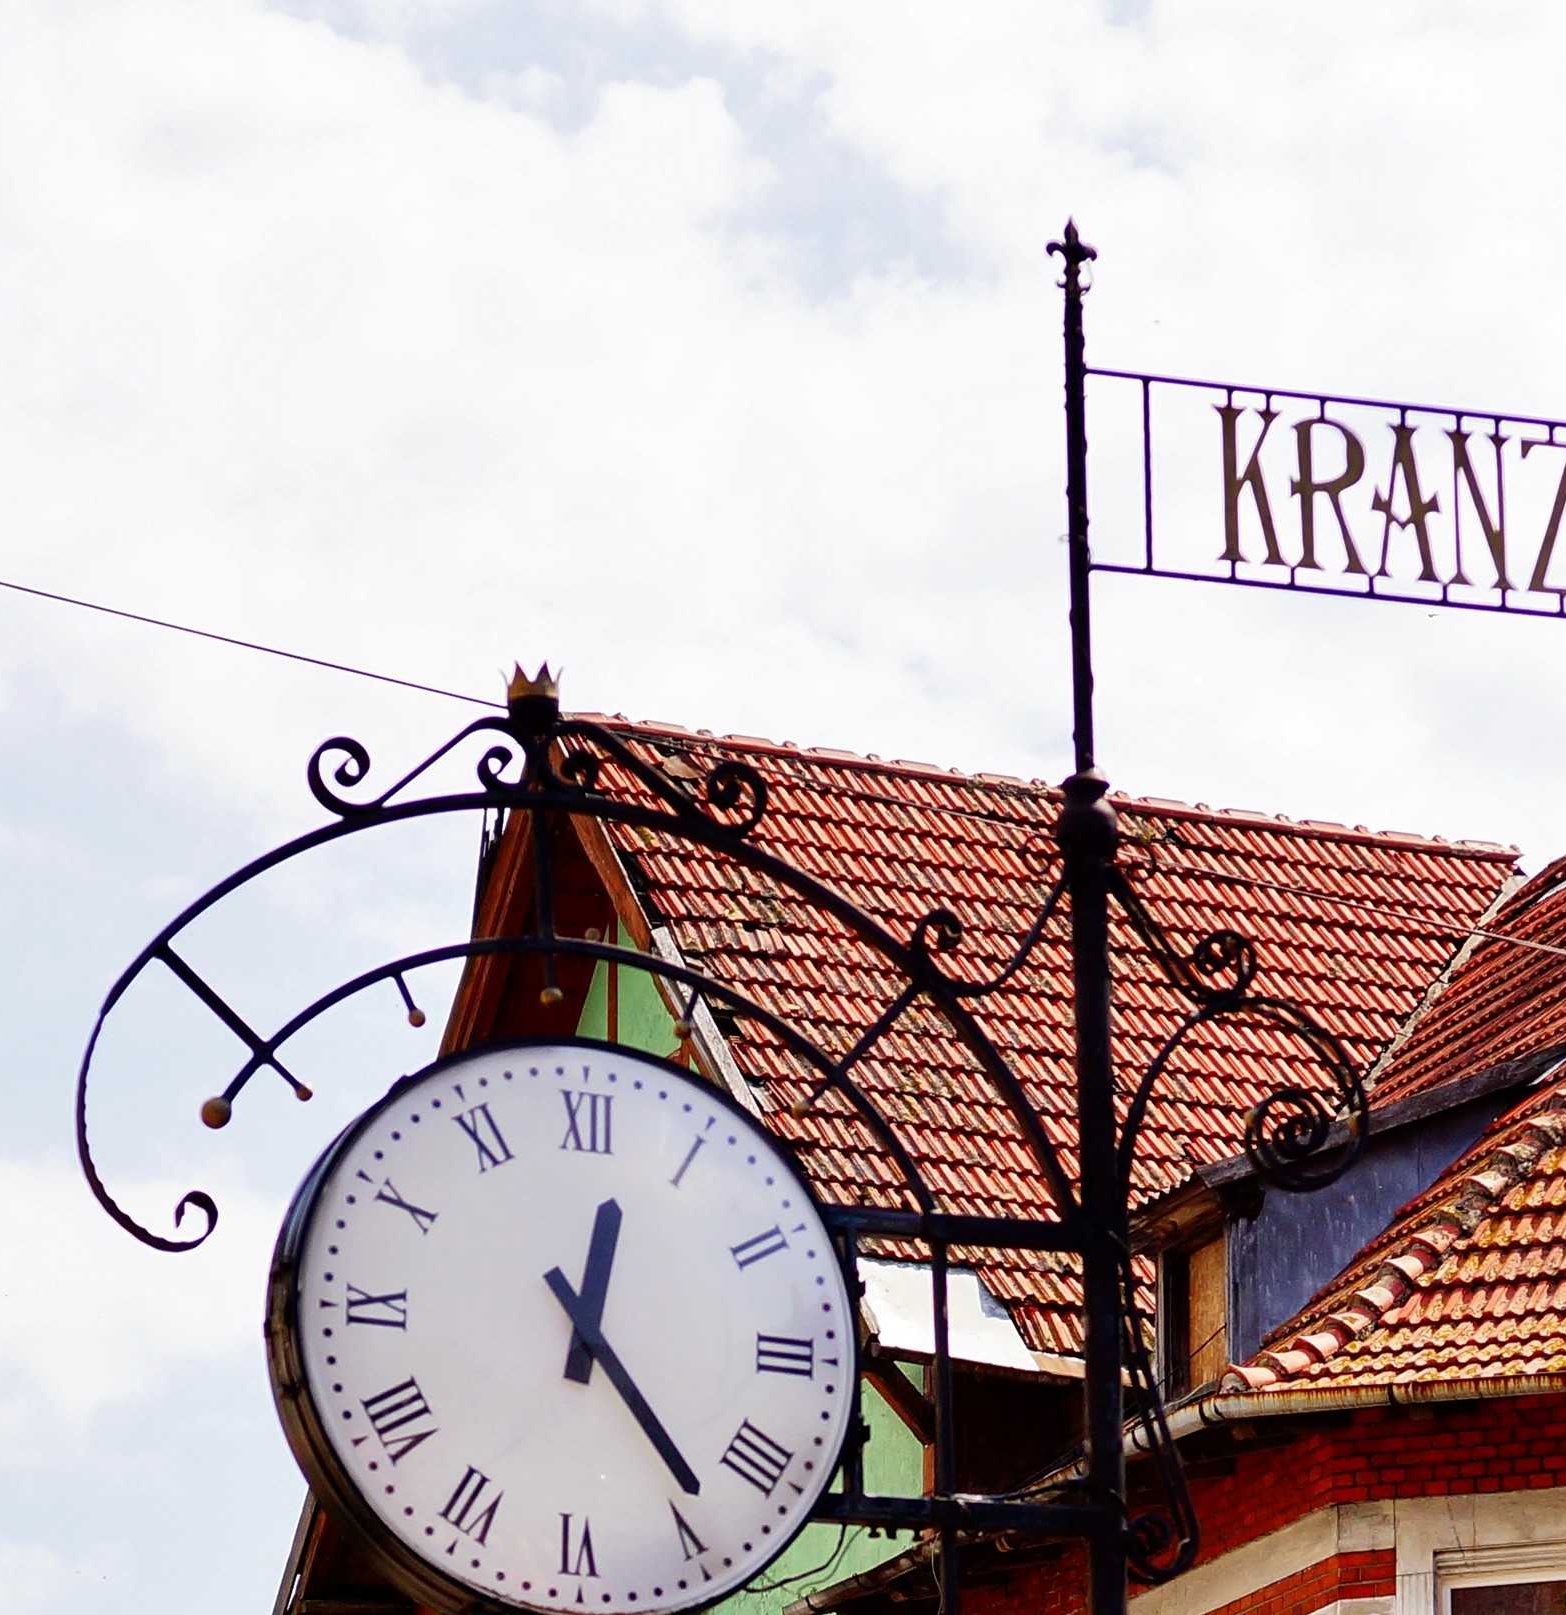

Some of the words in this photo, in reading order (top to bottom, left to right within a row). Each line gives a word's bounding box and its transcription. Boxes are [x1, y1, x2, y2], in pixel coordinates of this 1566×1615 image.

[452, 1102, 515, 1173] XI
[560, 1090, 614, 1154] XII
[671, 1135, 706, 1188] I
[374, 1178, 439, 1235] X
[729, 1225, 790, 1271] II
[345, 1283, 408, 1331] IX
[755, 1332, 814, 1380] III
[360, 1377, 439, 1467] VIII
[438, 1465, 504, 1547] VII
[669, 1500, 709, 1563] V
[558, 1512, 601, 1578] VI
